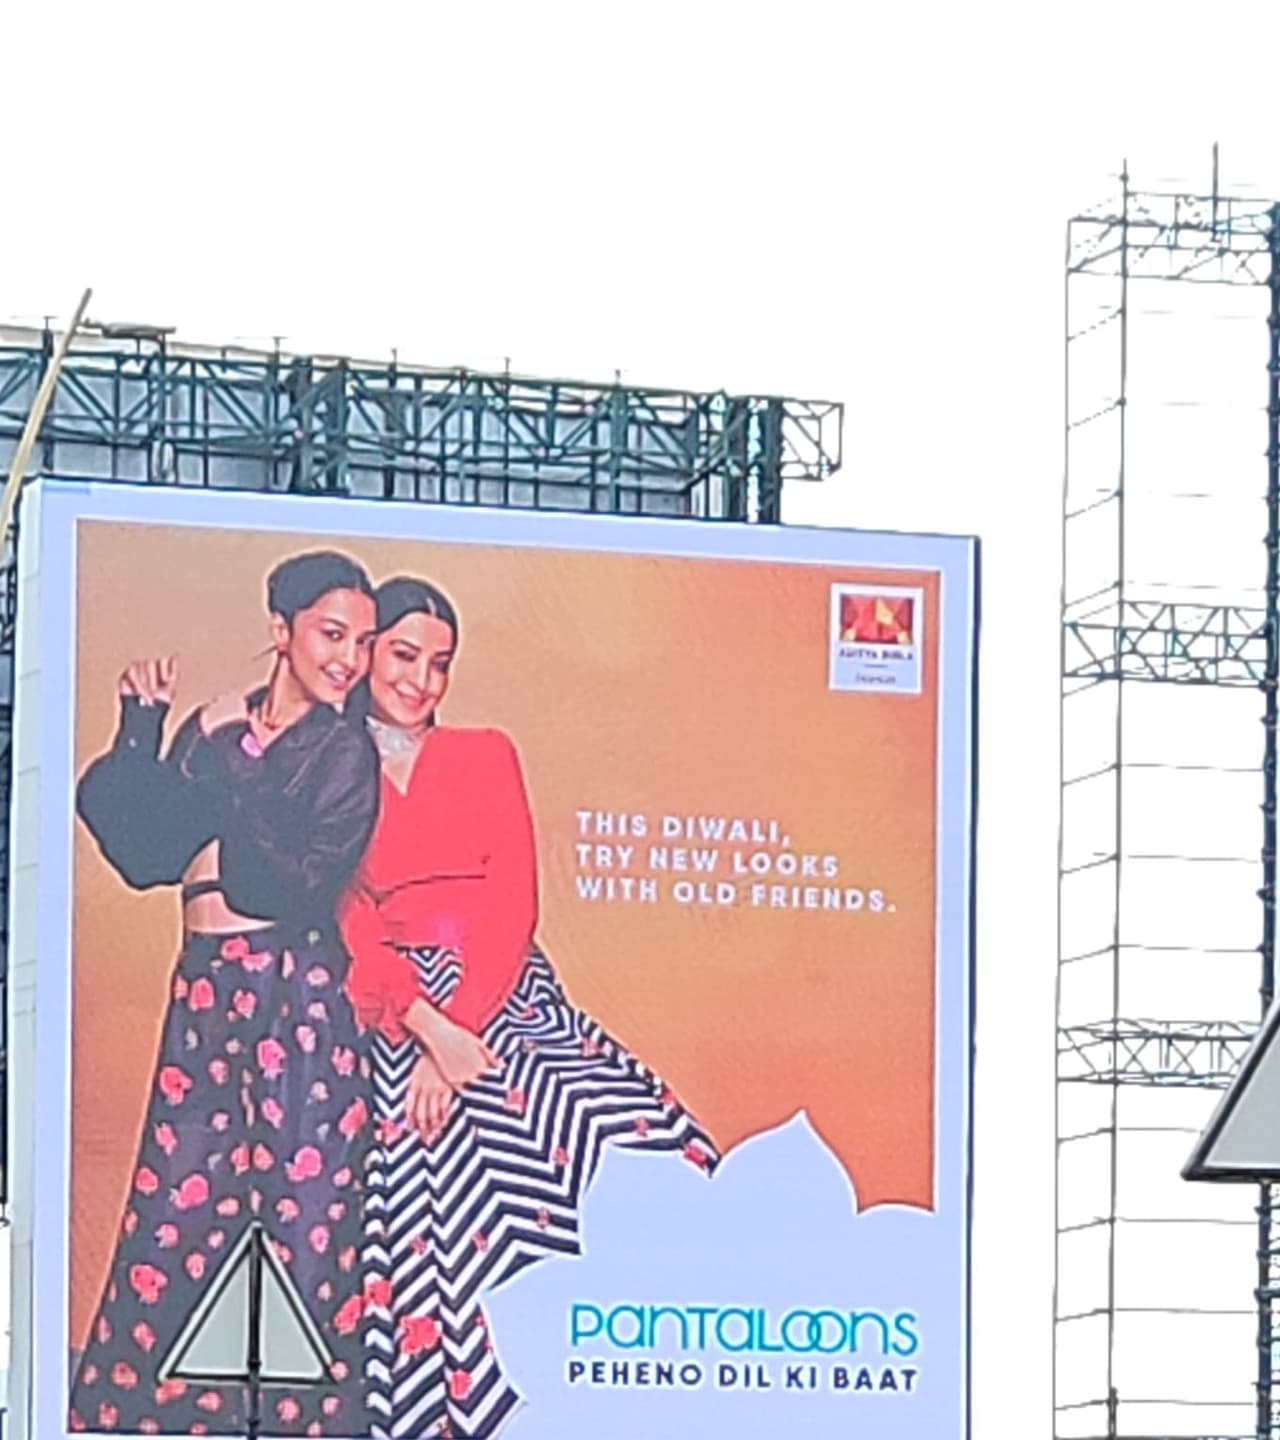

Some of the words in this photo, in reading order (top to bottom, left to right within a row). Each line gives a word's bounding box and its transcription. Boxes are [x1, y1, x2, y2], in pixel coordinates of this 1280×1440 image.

[576, 811, 648, 837] THIS
[662, 816, 791, 848] DIWALI,
[576, 844, 635, 868] TRY
[650, 846, 718, 873] NEW
[733, 851, 840, 878] LOOKS
[576, 876, 658, 903] WITH
[673, 881, 736, 906] OLD
[751, 884, 896, 913] FRIENDS.
[569, 1361, 703, 1387] PEHENO
[719, 1364, 771, 1388] DIL
[786, 1366, 817, 1389] KI
[833, 1367, 918, 1391] BAAT
